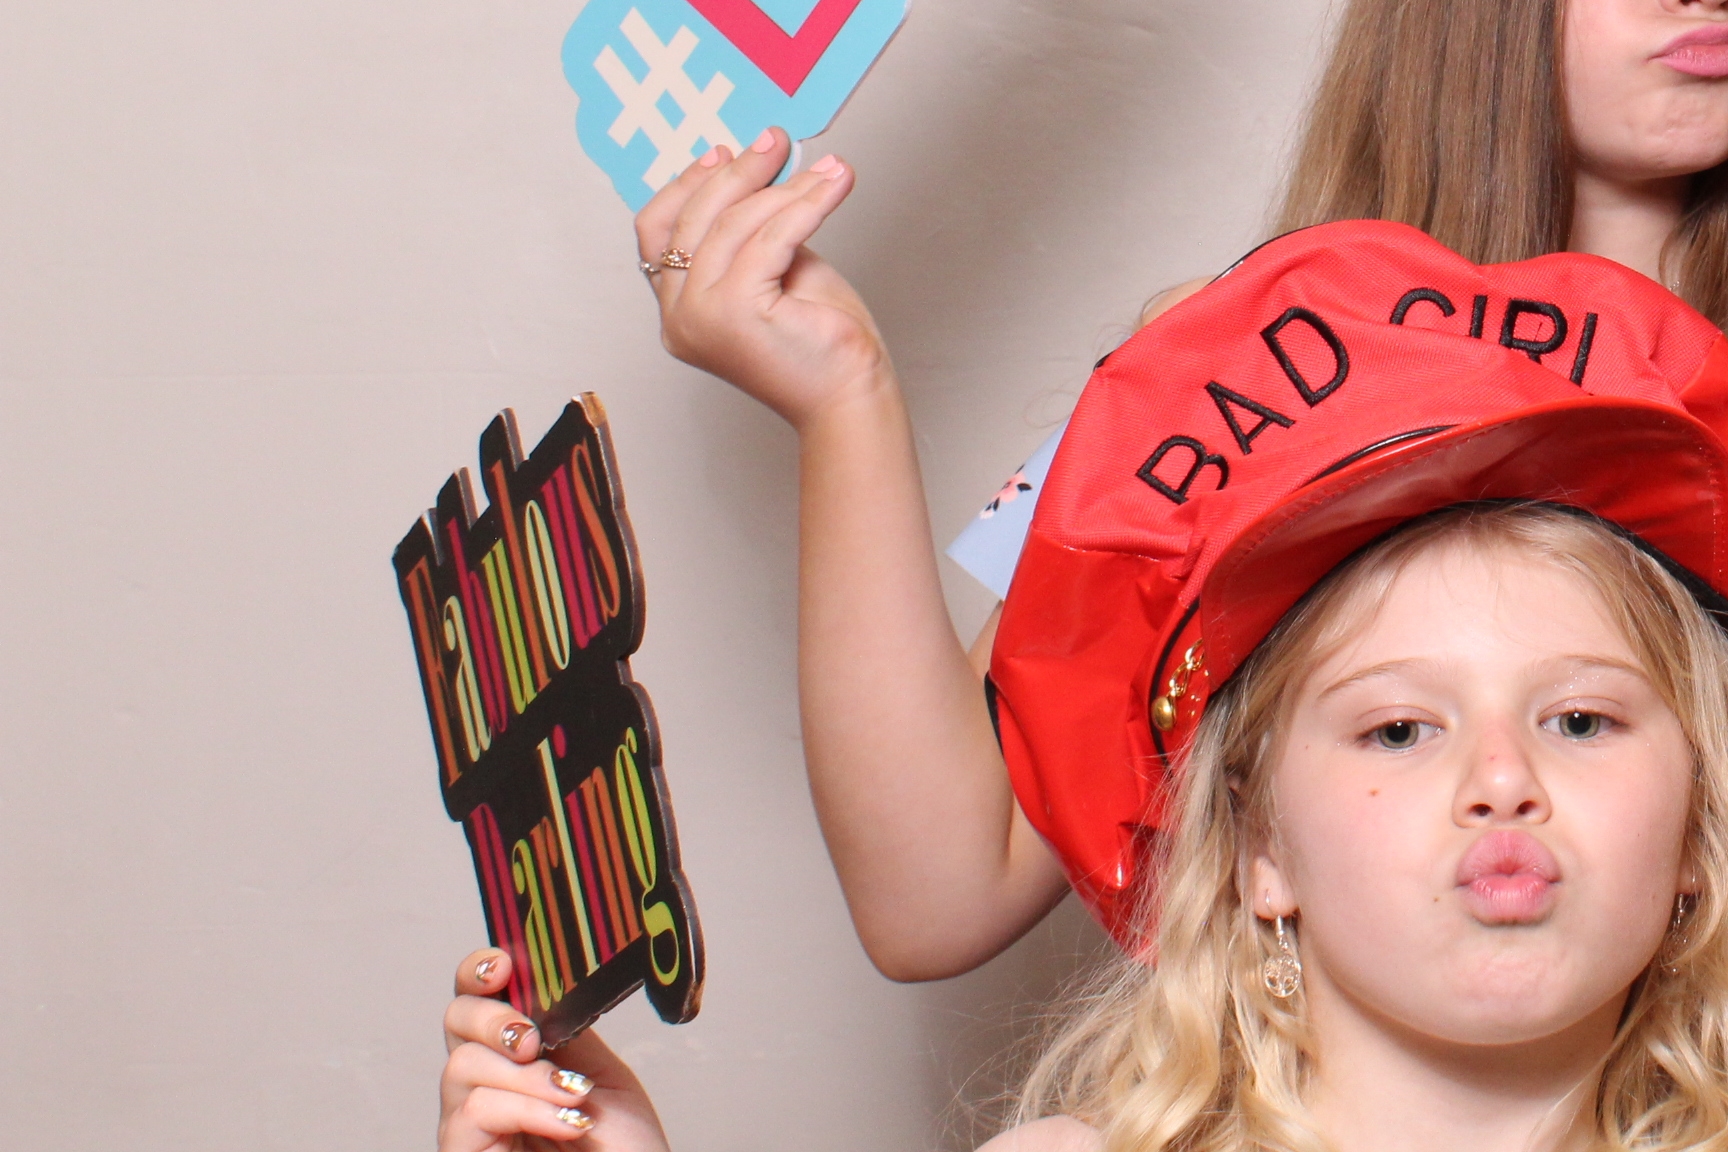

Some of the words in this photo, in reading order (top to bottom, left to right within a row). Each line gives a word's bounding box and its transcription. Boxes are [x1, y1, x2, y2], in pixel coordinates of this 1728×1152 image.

[1135, 306, 1350, 505] BAD
[404, 434, 621, 788] Fabulous
[469, 726, 681, 1018] Darling
